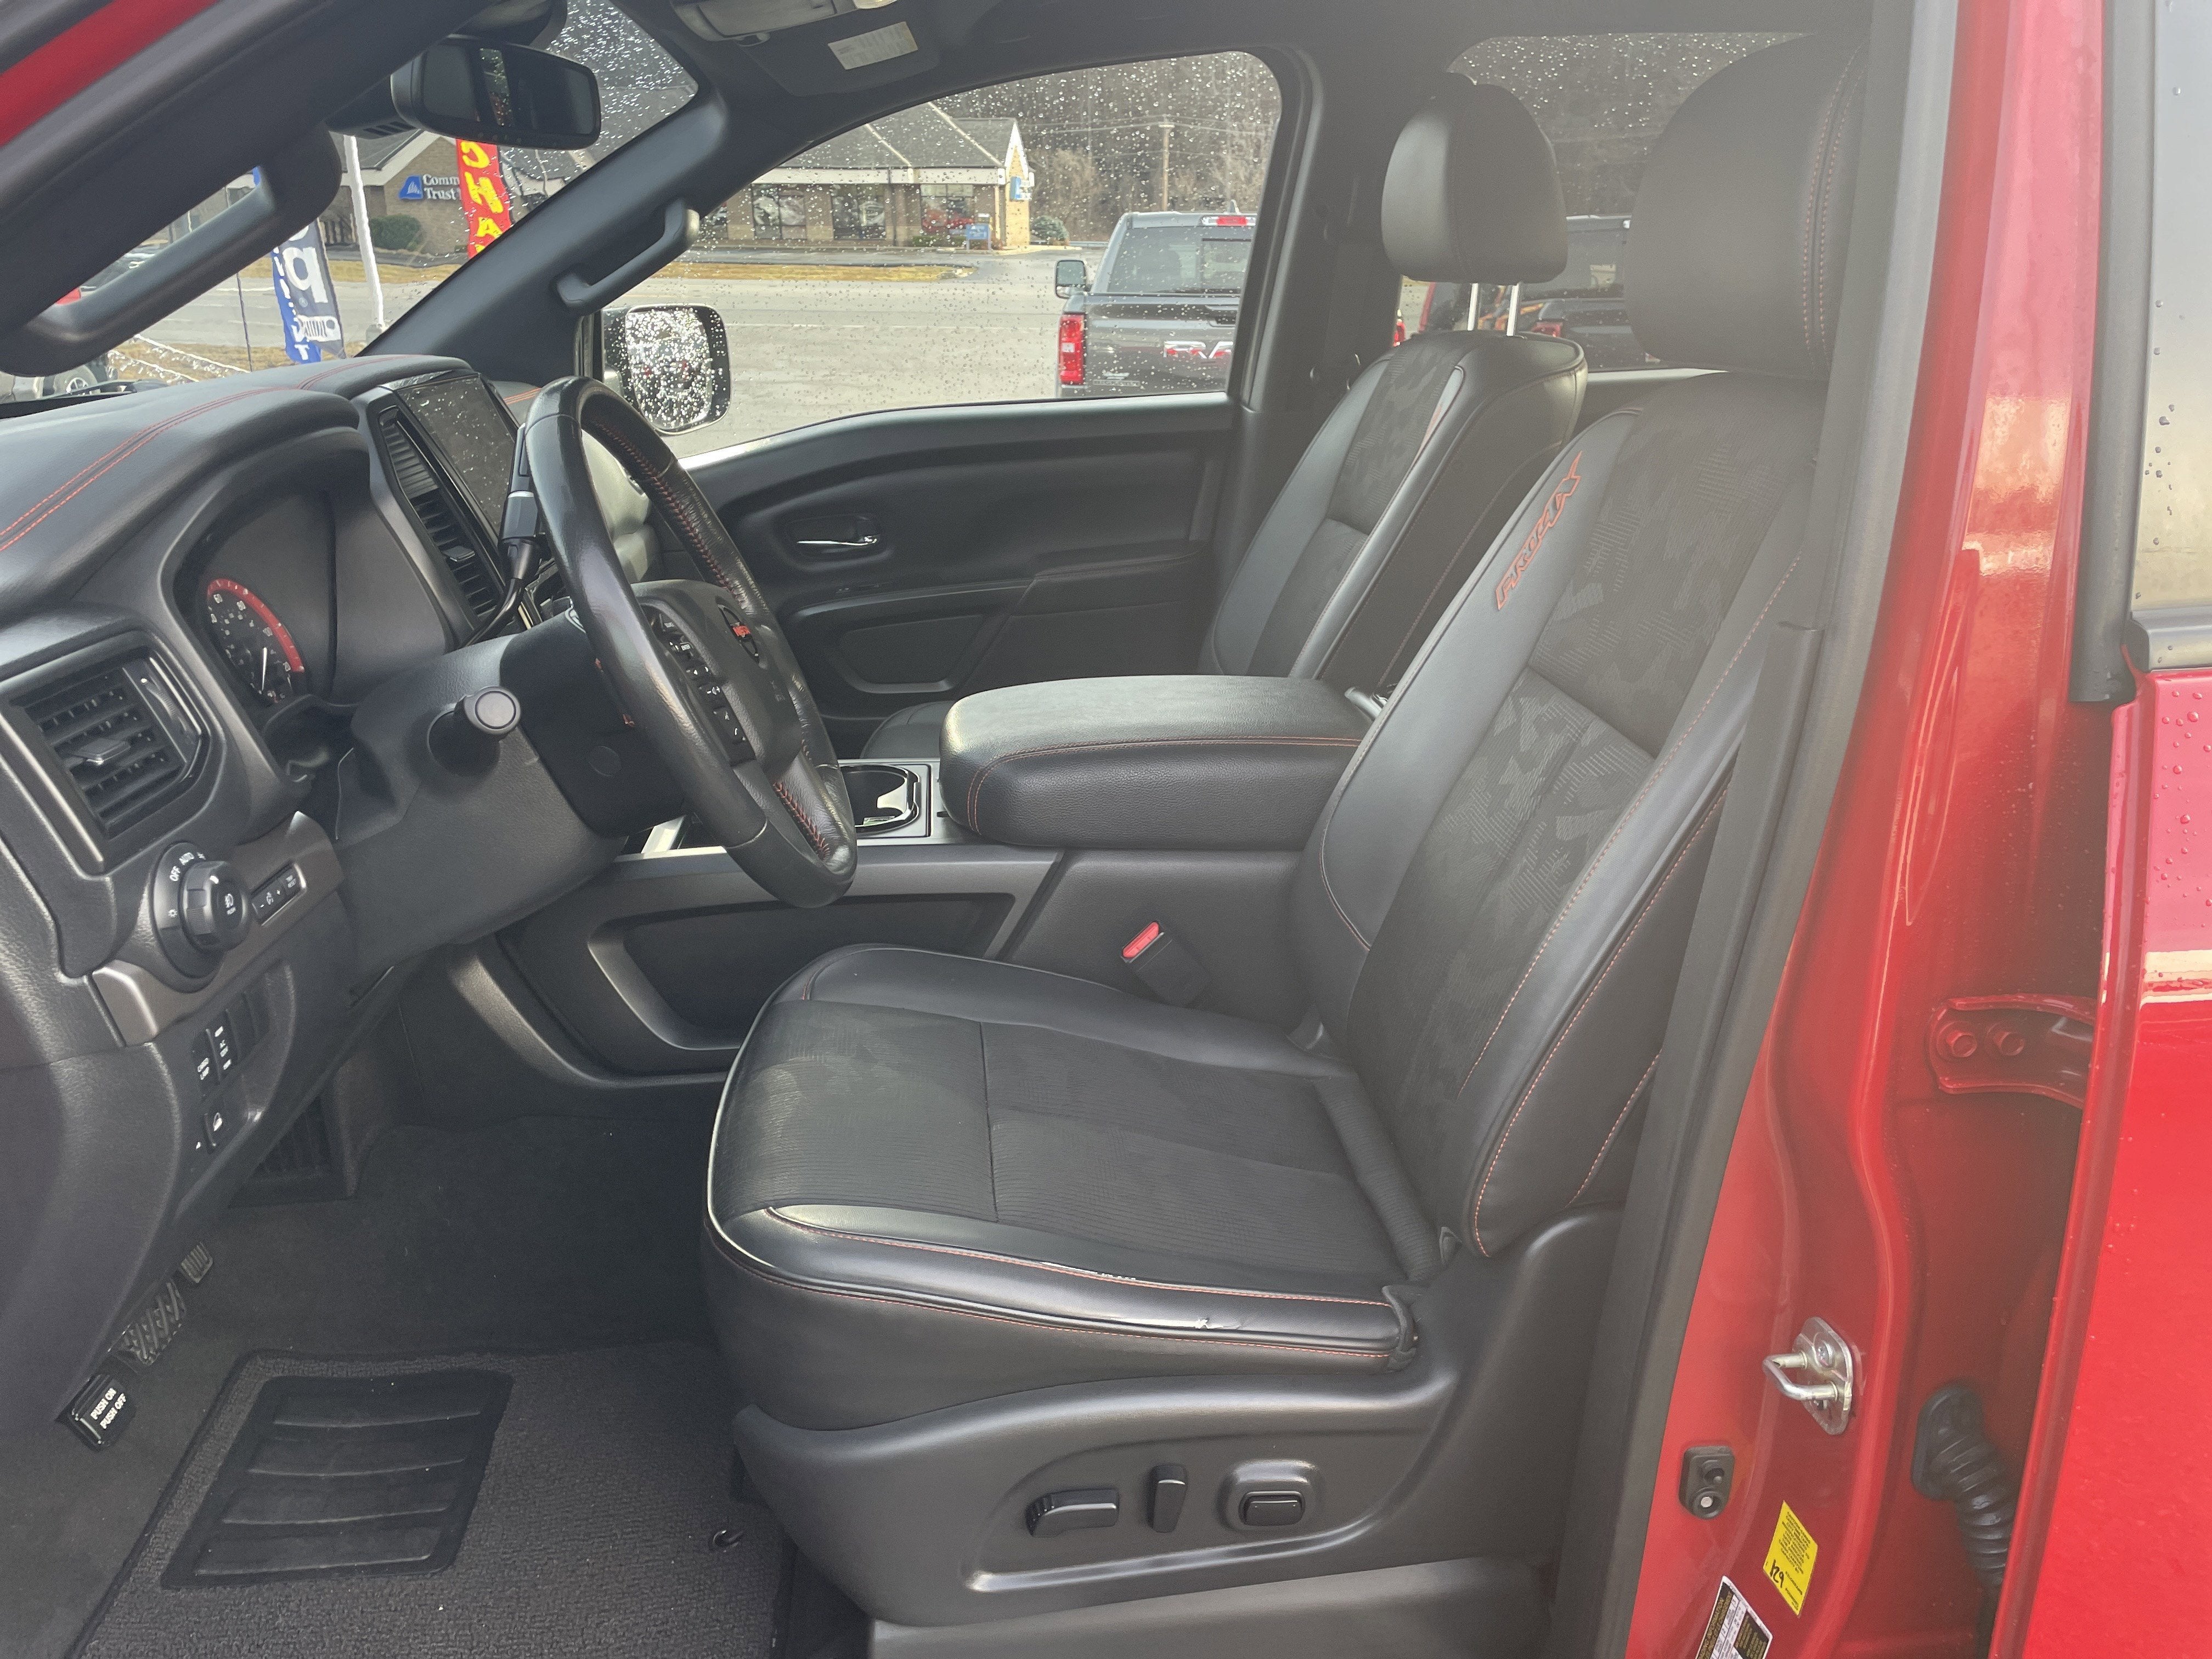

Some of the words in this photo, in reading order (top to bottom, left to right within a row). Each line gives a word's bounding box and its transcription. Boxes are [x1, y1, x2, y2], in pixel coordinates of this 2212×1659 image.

[424, 187, 456, 200] Trust
[1164, 341, 1233, 358] RA
[170, 866, 180, 882] OFF
[90, 1398, 109, 1420] PUSH
[105, 1388, 116, 1401] ON
[100, 1407, 117, 1429] PUSH
[114, 1393, 126, 1409] OFF
